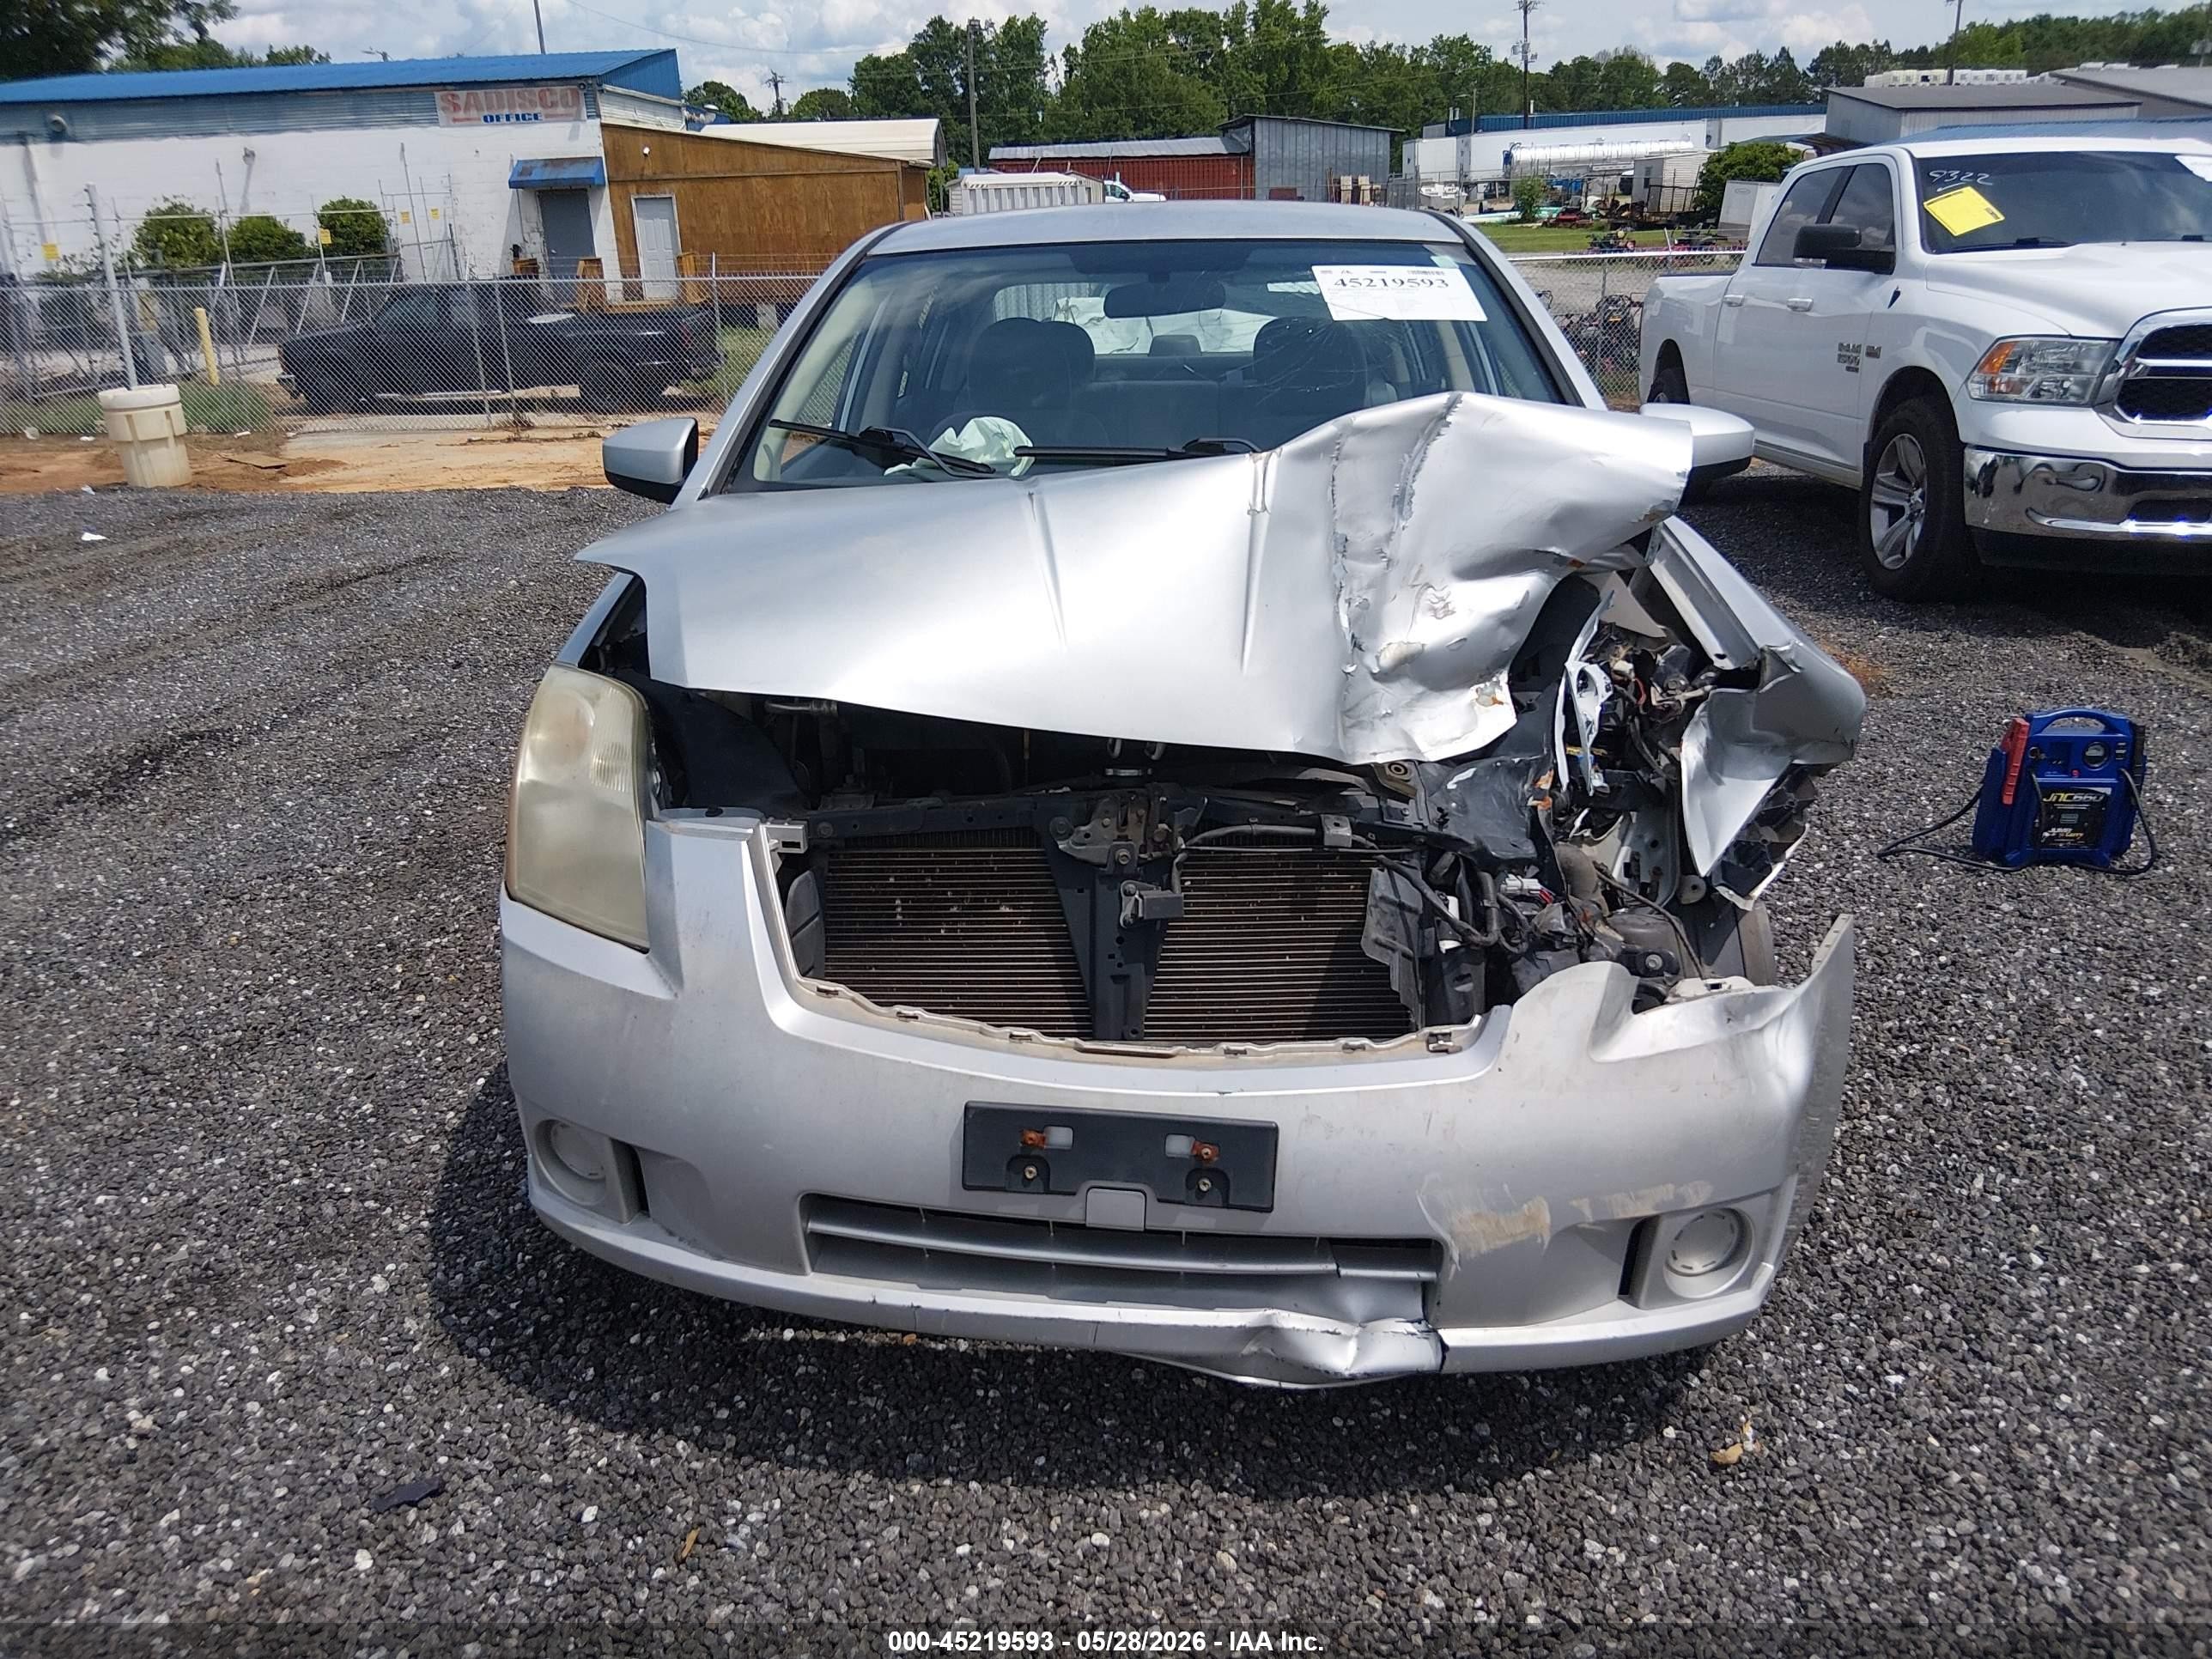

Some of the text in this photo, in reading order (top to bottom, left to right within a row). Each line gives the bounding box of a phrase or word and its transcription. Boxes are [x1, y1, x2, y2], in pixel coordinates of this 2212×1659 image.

[440, 88, 580, 113] SADISCO
[483, 112, 543, 124] OFFICE
[1334, 277, 1449, 289] 45219593
